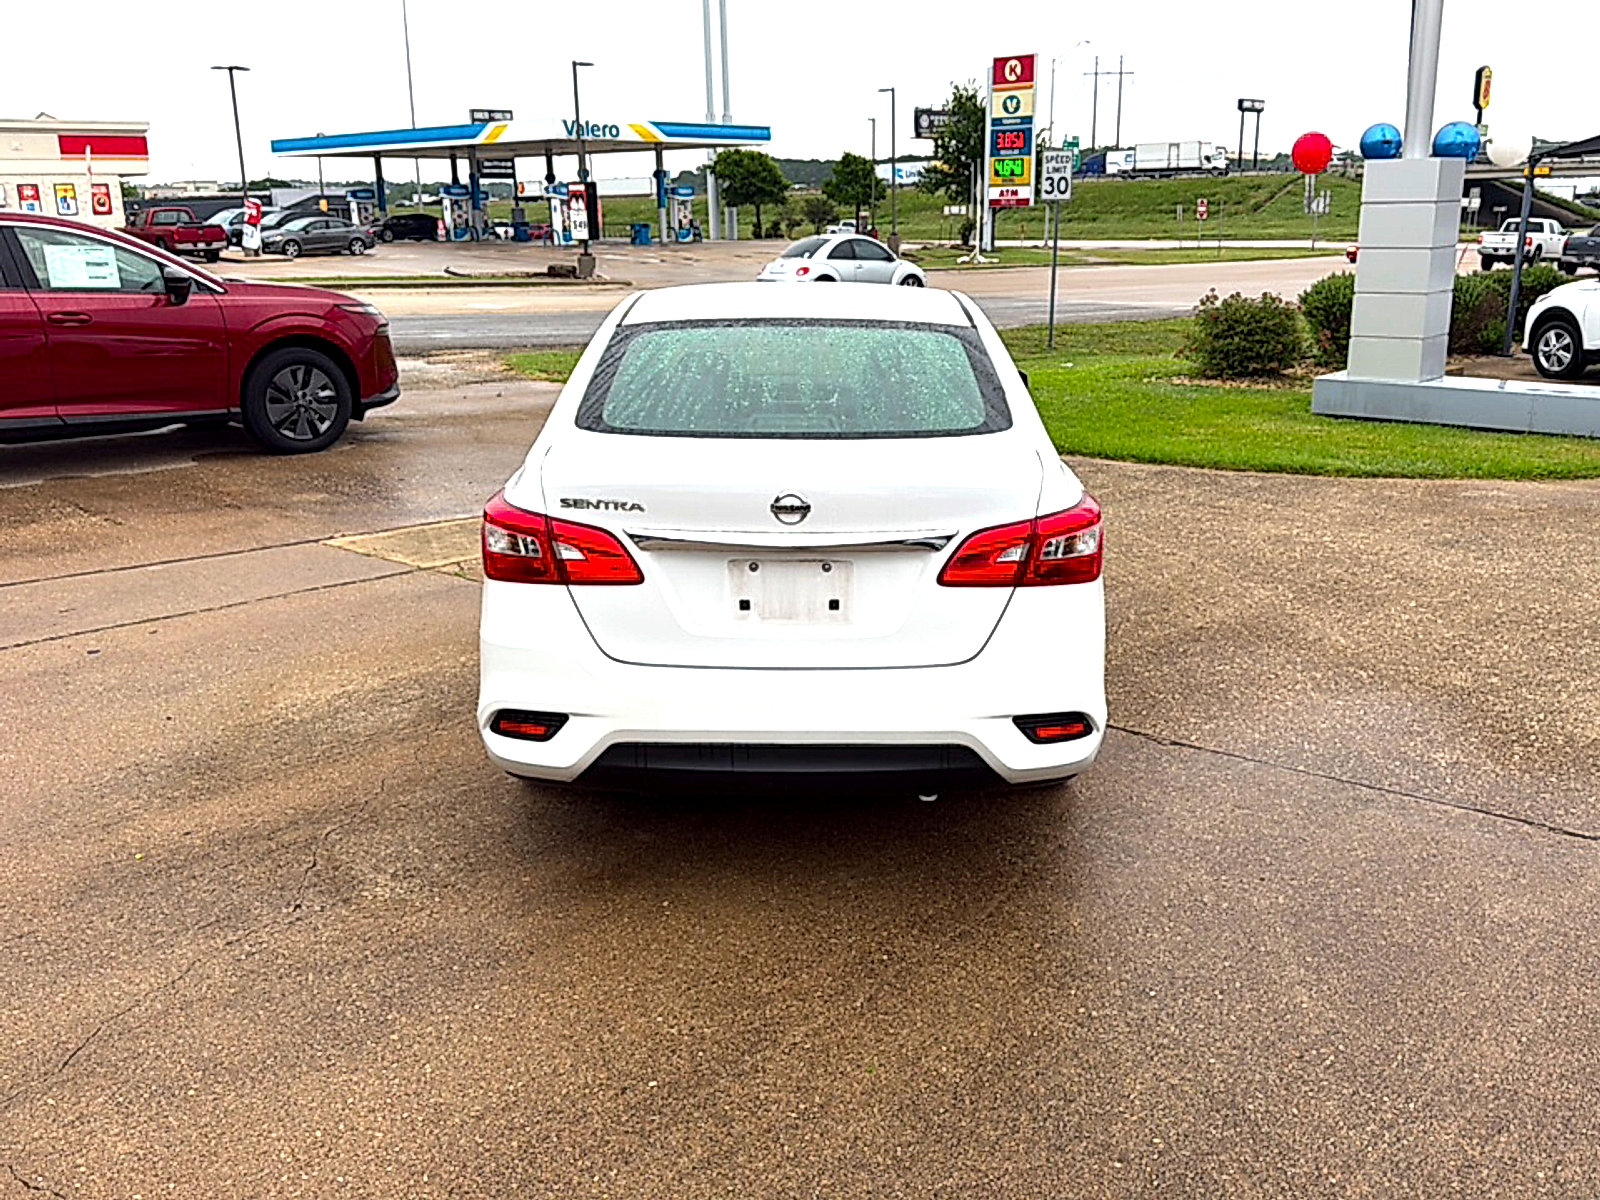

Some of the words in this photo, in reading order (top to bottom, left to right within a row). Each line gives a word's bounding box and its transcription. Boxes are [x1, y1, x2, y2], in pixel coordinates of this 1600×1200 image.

[561, 119, 620, 138] Valero
[1045, 154, 1070, 164] SPEED
[1046, 166, 1067, 174] LIMIT
[1044, 176, 1070, 194] 30
[999, 188, 1019, 198] ATM
[560, 498, 645, 512] SENTRA
